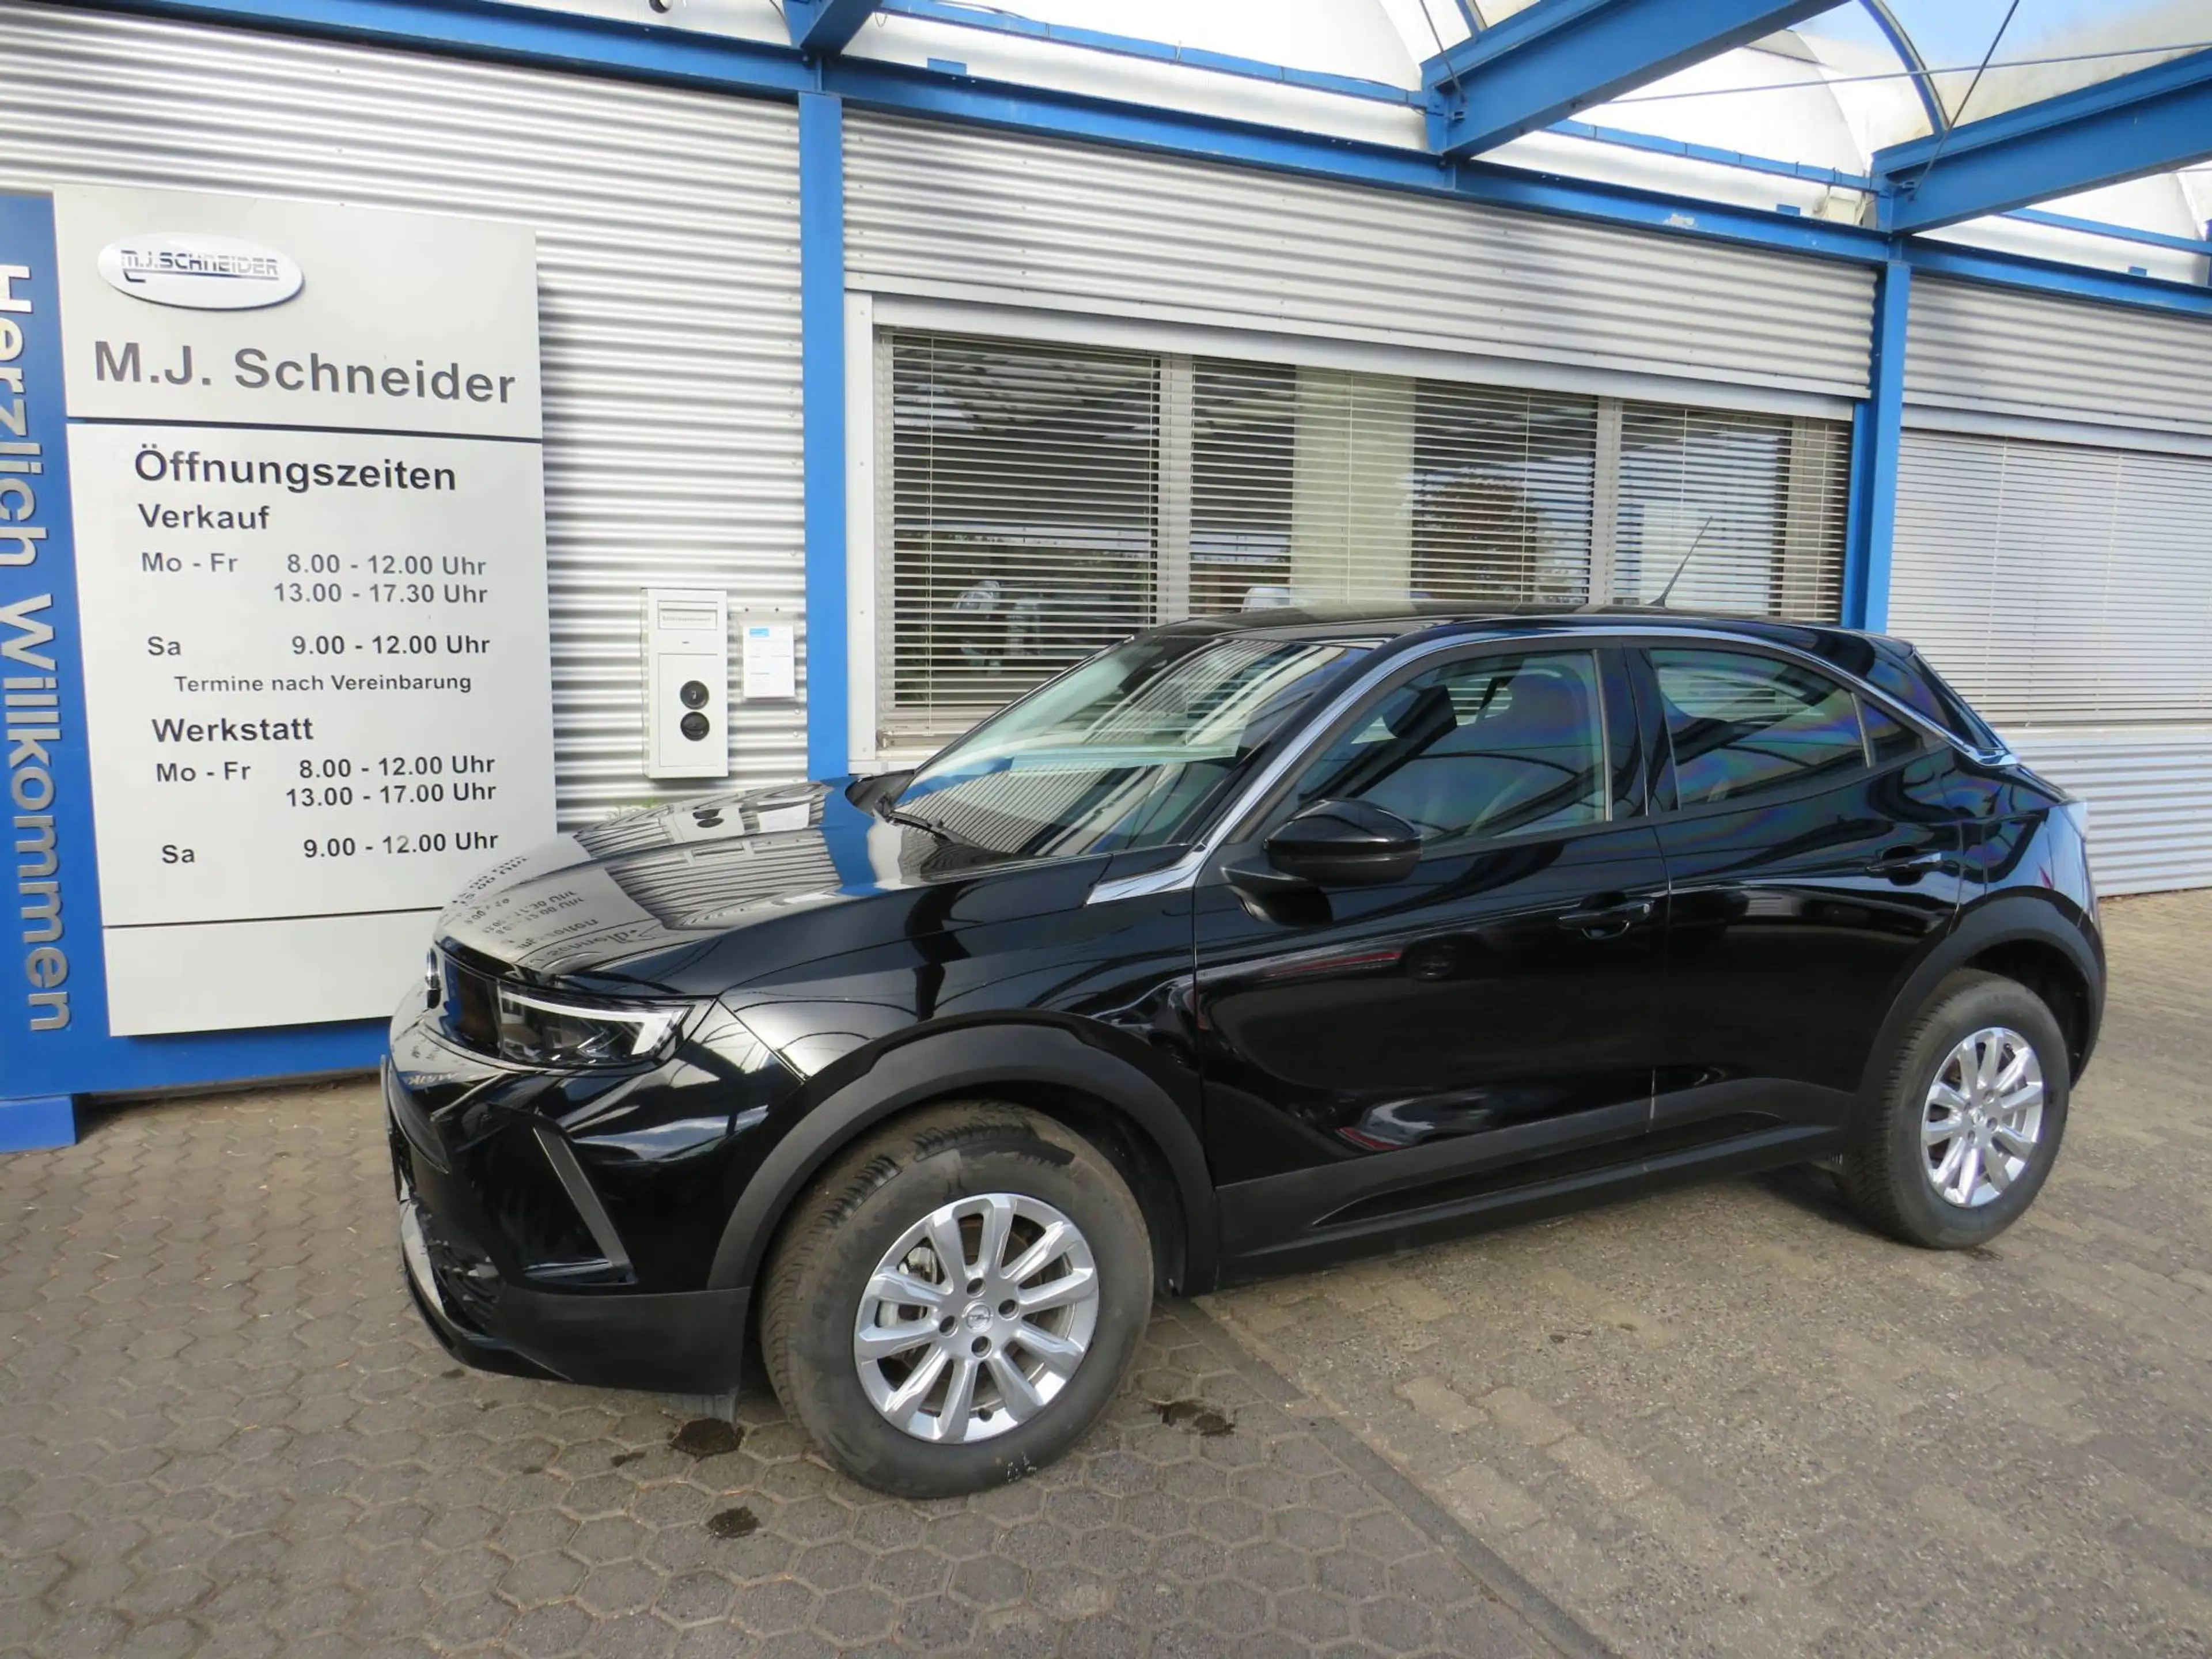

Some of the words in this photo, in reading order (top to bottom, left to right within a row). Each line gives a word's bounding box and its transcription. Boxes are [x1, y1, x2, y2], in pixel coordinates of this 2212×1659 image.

[94, 340, 211, 386] M.J.
[234, 348, 516, 404] Schneider
[0, 265, 48, 567] Herzlich
[135, 444, 456, 494] Öffnungszeiten
[138, 503, 270, 529] Verkauf
[142, 552, 182, 572] Mo
[210, 552, 238, 573] Fr
[287, 554, 340, 574] 8.00
[368, 555, 433, 575] 12.00
[442, 556, 486, 575] Uhr
[274, 582, 342, 603] 13.00
[369, 584, 434, 603] 17.30
[444, 584, 488, 603] Uhr
[147, 636, 181, 656] Sa
[291, 635, 345, 655] 9.00
[372, 635, 437, 654] 12.00
[446, 635, 490, 654] Uhr
[173, 676, 264, 692] Termine
[272, 675, 324, 691] nach
[331, 674, 471, 694] Vereinbarung
[151, 717, 314, 743] Werkstatt
[156, 763, 196, 782] Mo
[224, 761, 251, 781] Fr
[300, 759, 351, 779] 8.00
[378, 756, 442, 777] 12.00
[452, 755, 495, 774] Uhr
[286, 786, 353, 807] 13.00
[380, 783, 444, 804] 17.00
[453, 782, 497, 801] Uhr
[0, 593, 71, 1031] Willkommen
[162, 844, 195, 864] Sa
[304, 838, 355, 858] 9.00
[382, 833, 446, 854] 12.00
[455, 831, 499, 850] Uhr
